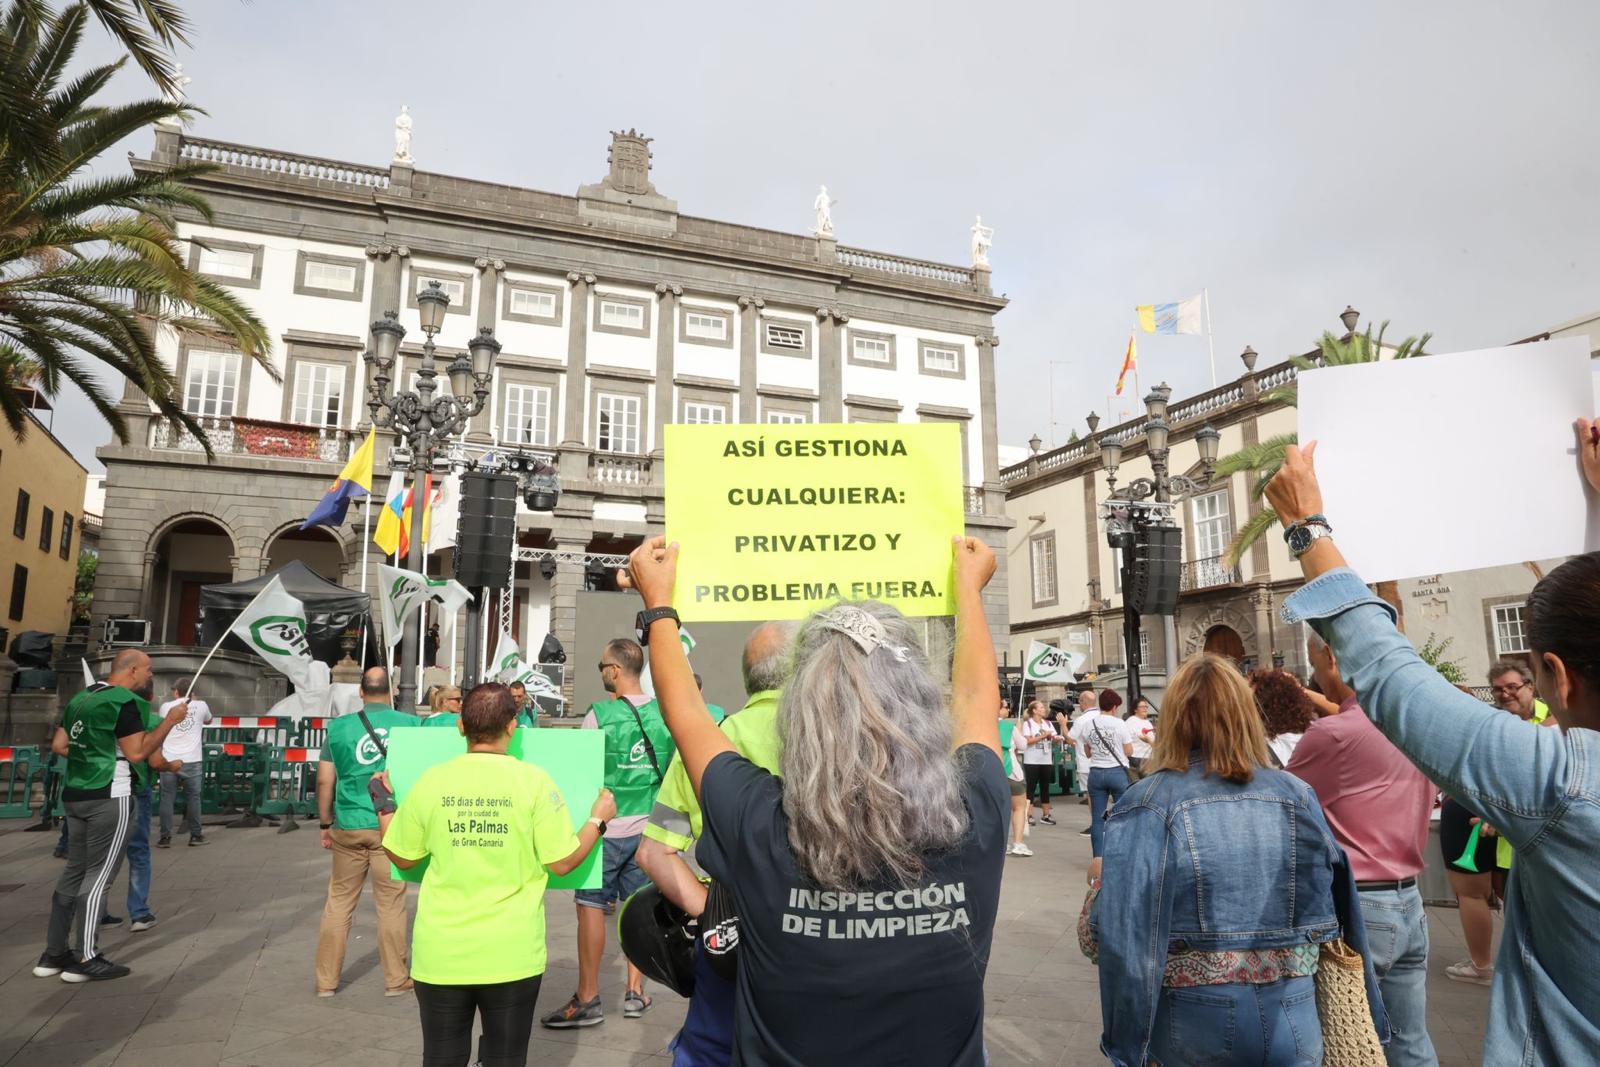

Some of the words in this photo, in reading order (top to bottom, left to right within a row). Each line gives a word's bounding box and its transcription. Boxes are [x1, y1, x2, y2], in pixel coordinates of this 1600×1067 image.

[723, 436, 765, 457] ASÍ
[775, 440, 908, 457] GESTIONA
[727, 487, 905, 506] CUALQUIERA:
[735, 534, 876, 553] PRIVATIZO
[885, 533, 902, 550] Y
[695, 583, 842, 602] PROBLEMA
[851, 580, 943, 601] FUERA.
[441, 796, 456, 807] 365
[475, 796, 485, 807] de
[486, 796, 514, 808] servici
[457, 810, 467, 818] por
[468, 809, 473, 817] la
[473, 809, 491, 818] ciudad
[492, 809, 499, 817] de
[447, 819, 466, 833] Las
[469, 819, 509, 834] Palmas
[452, 837, 460, 847] de
[461, 837, 477, 847] Gran
[478, 838, 504, 848] Canaria
[788, 882, 967, 912] INSPECCIÓN
[781, 913, 823, 938] DE
[827, 907, 971, 939] LIMPIEZA
